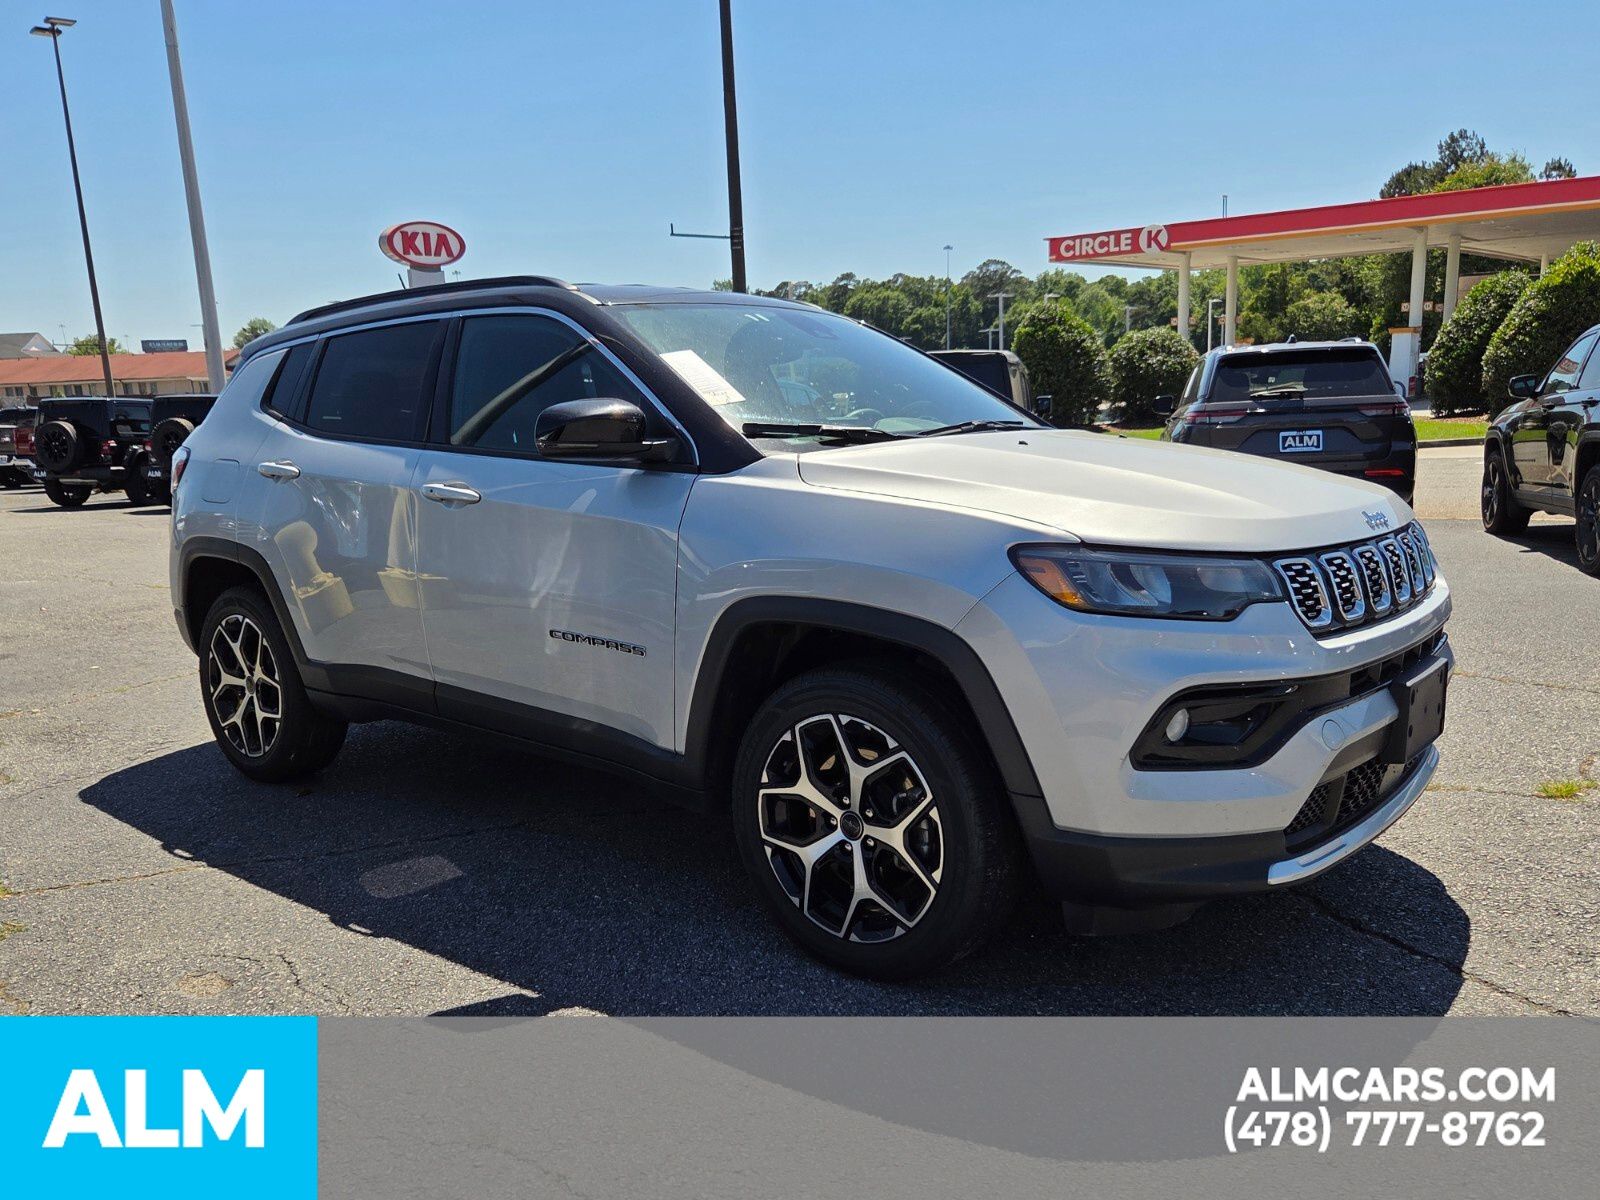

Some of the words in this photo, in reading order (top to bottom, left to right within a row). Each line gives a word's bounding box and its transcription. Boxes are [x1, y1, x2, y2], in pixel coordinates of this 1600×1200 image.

[401, 231, 454, 258] KIA
[1060, 233, 1131, 257] CIRCLE
[1146, 229, 1164, 251] K
[1284, 435, 1317, 447] ALM
[549, 629, 646, 657] COMPASS
